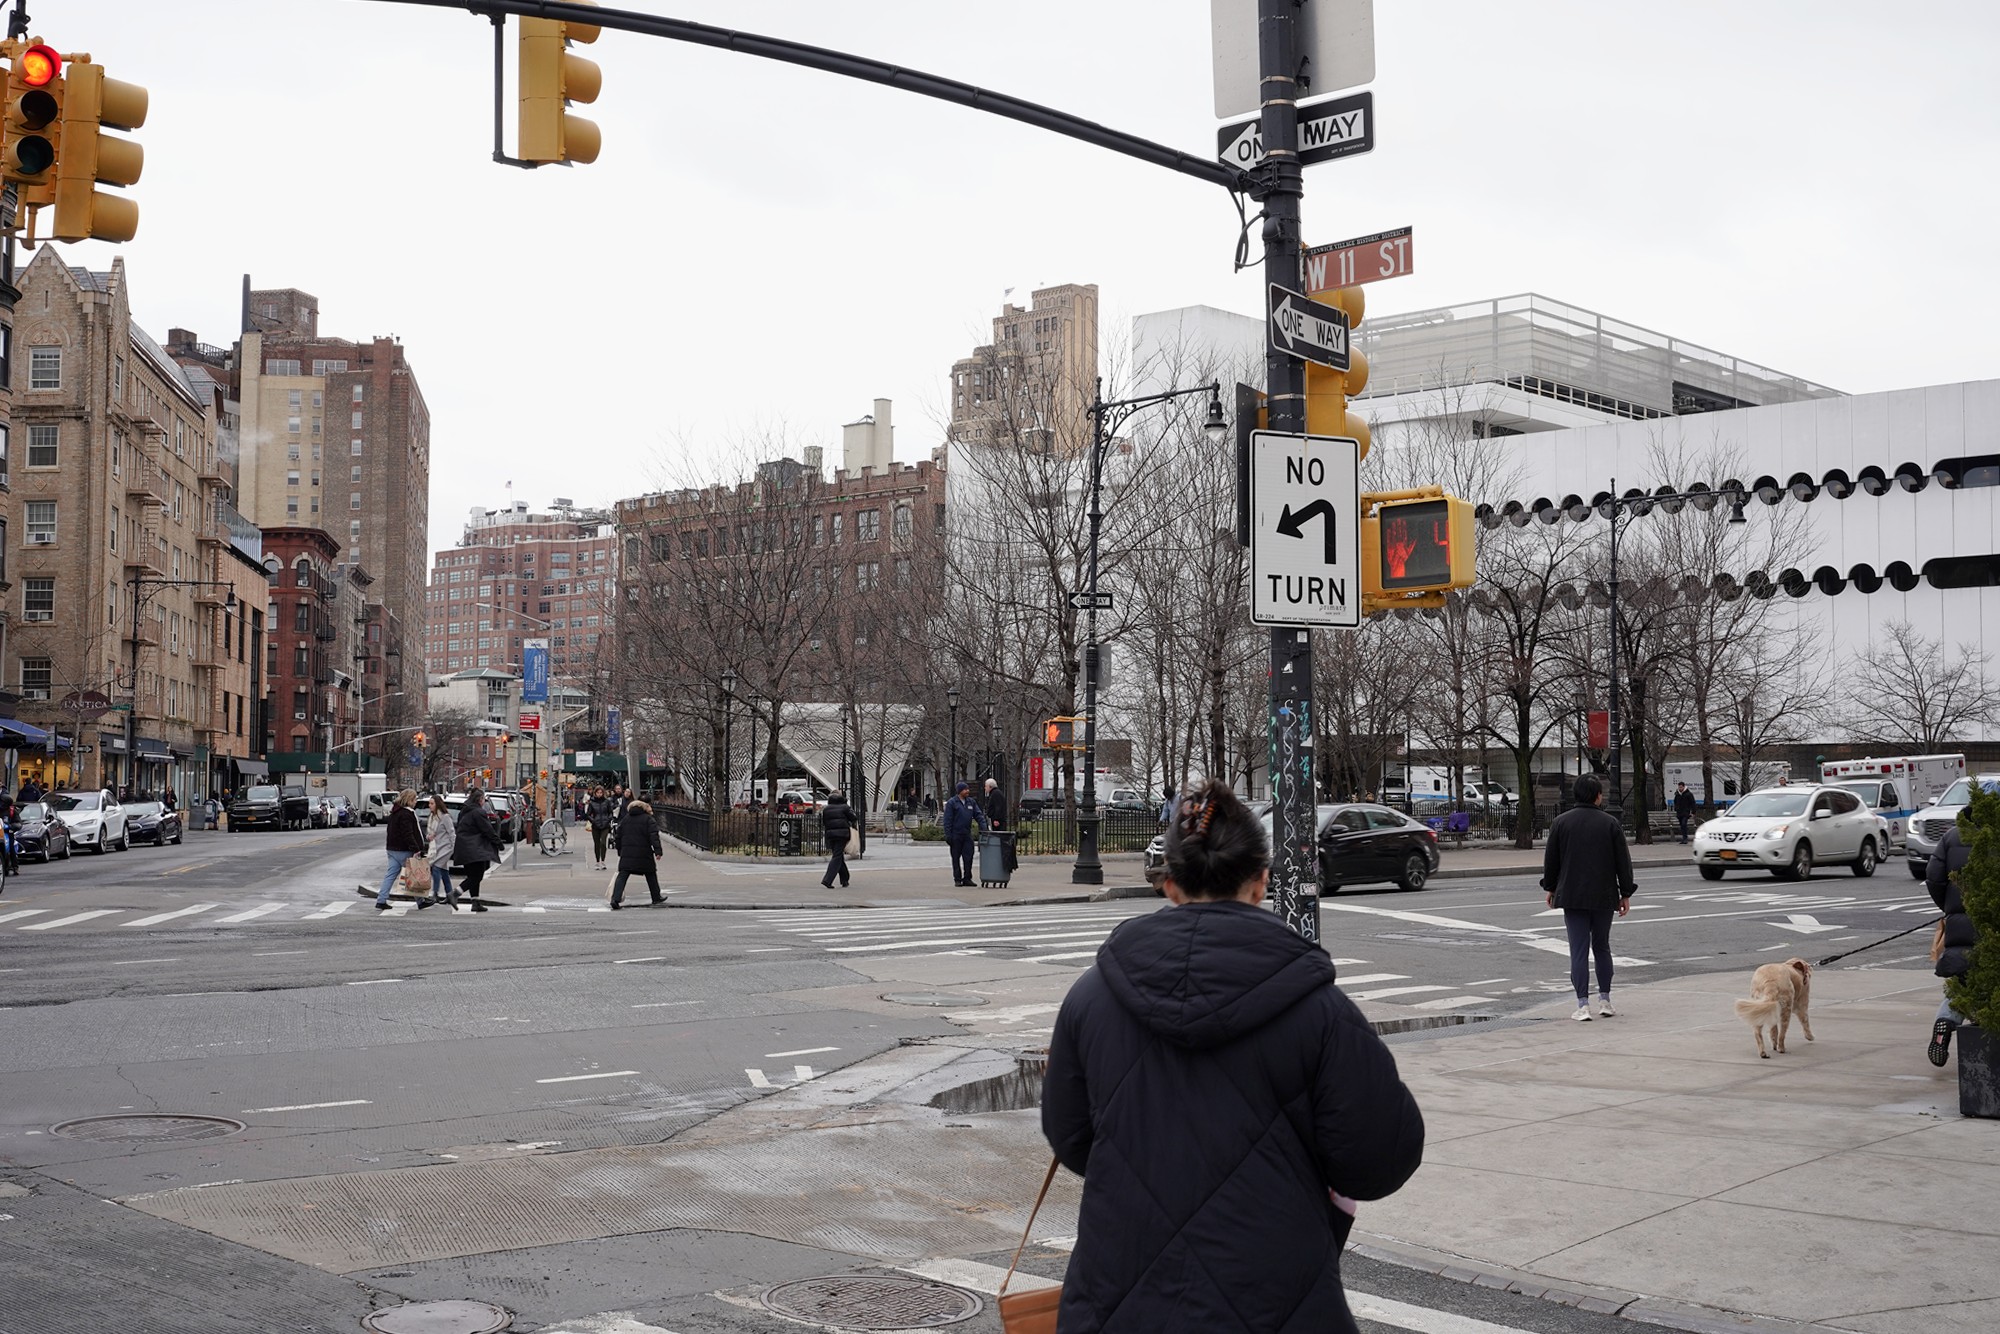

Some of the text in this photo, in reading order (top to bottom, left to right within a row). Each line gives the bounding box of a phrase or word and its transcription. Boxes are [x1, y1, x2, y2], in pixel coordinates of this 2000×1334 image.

[1238, 112, 1359, 162] ON WAY
[1334, 241, 1355, 250] VILLAGE
[1356, 235, 1380, 245] HISTORIC
[1381, 229, 1405, 240] DISTRICT
[1307, 237, 1409, 292] W 11 ST
[1281, 308, 1342, 350] ONE WAY
[1286, 455, 1325, 486] NO
[1076, 597, 1090, 605] ONE
[1267, 574, 1345, 606] TURN
